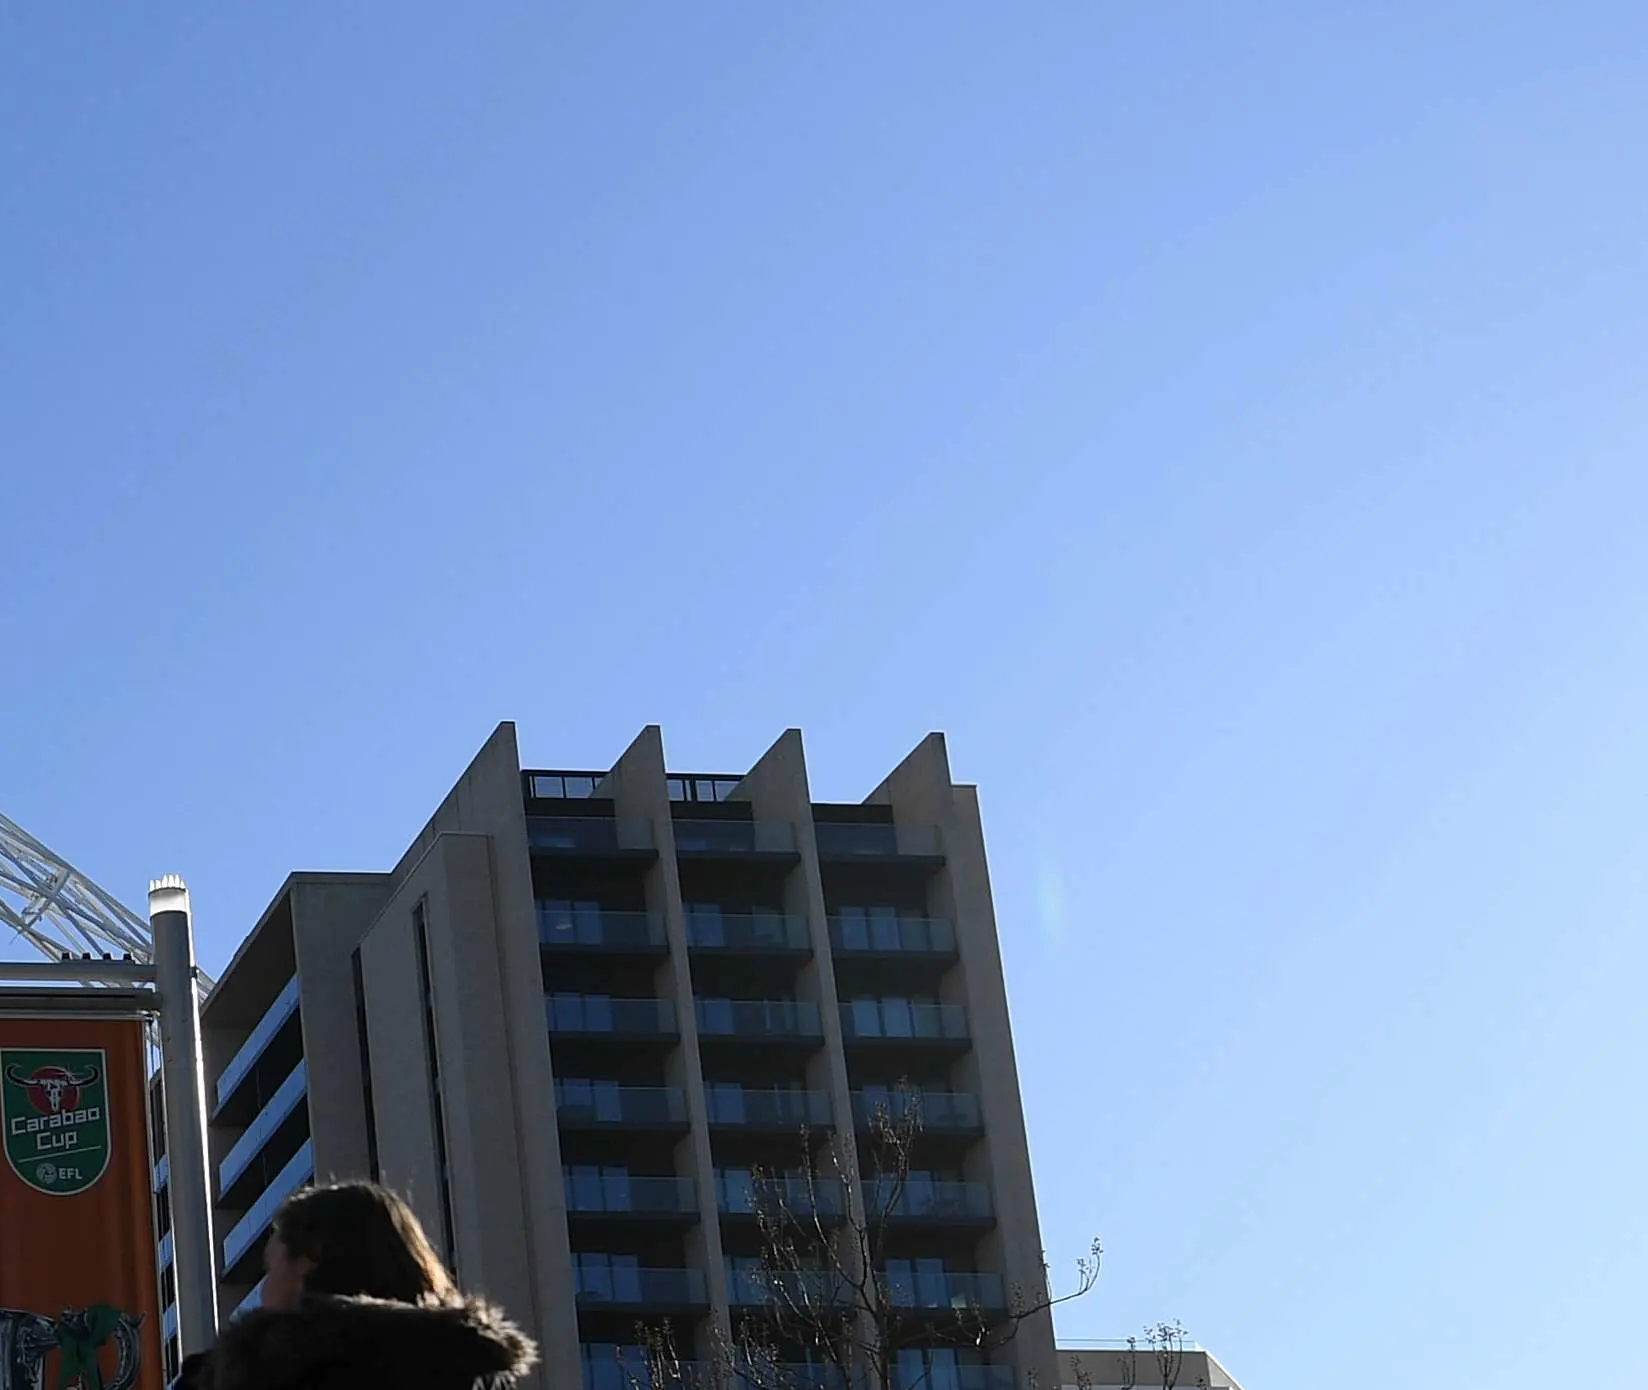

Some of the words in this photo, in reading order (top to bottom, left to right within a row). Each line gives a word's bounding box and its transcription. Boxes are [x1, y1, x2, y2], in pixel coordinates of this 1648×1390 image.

[11, 1107, 100, 1135] Carabao
[36, 1131, 77, 1150] Cup
[59, 1168, 83, 1180] EFL
